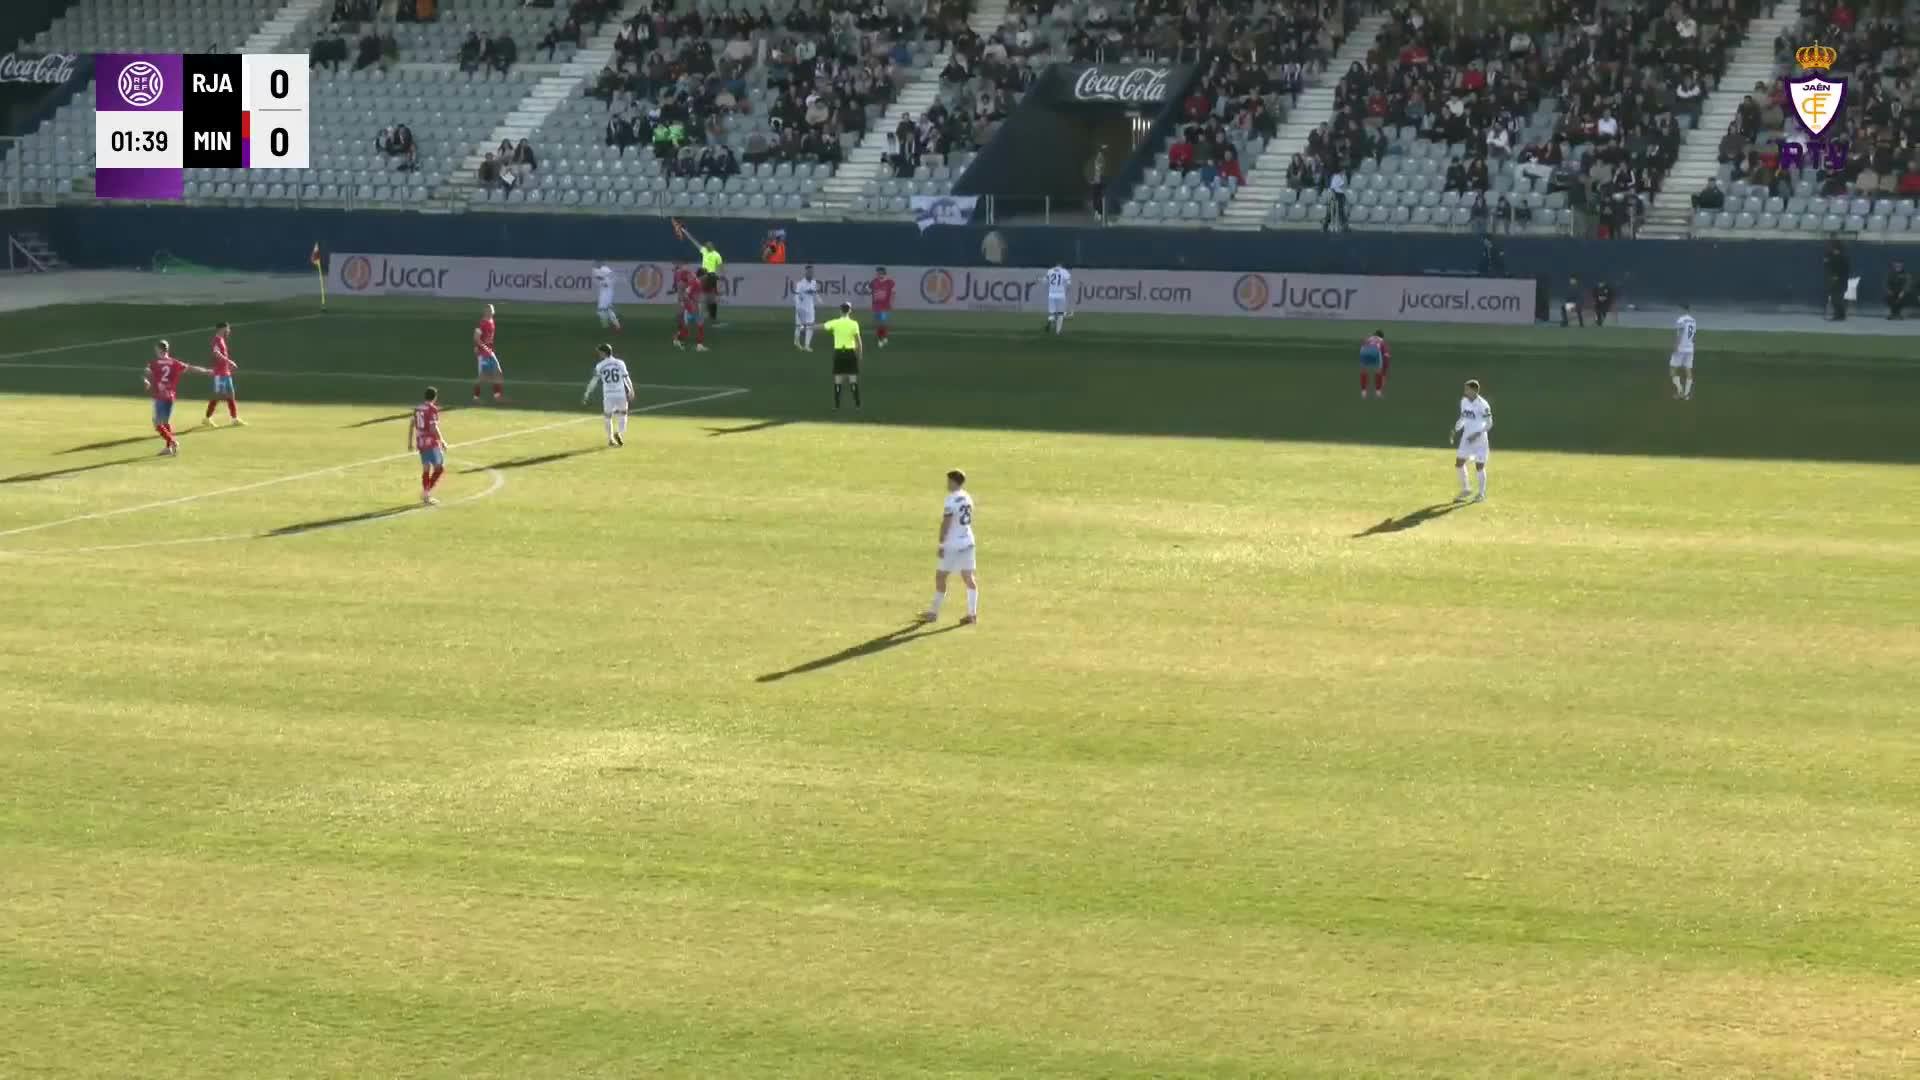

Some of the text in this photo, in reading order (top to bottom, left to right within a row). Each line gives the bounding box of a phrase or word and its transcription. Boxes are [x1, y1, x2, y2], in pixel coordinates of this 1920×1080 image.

[376, 258, 448, 289] Jucar
[484, 268, 592, 291] jucarsl.com
[1050, 273, 1062, 287] 21
[958, 271, 1036, 302] Jucar
[1075, 280, 1192, 304] jucarsl.com
[1271, 278, 1358, 310] Jucar
[1399, 289, 1521, 313] jucarsl.com
[161, 365, 171, 382] 2
[603, 368, 620, 384] 26
